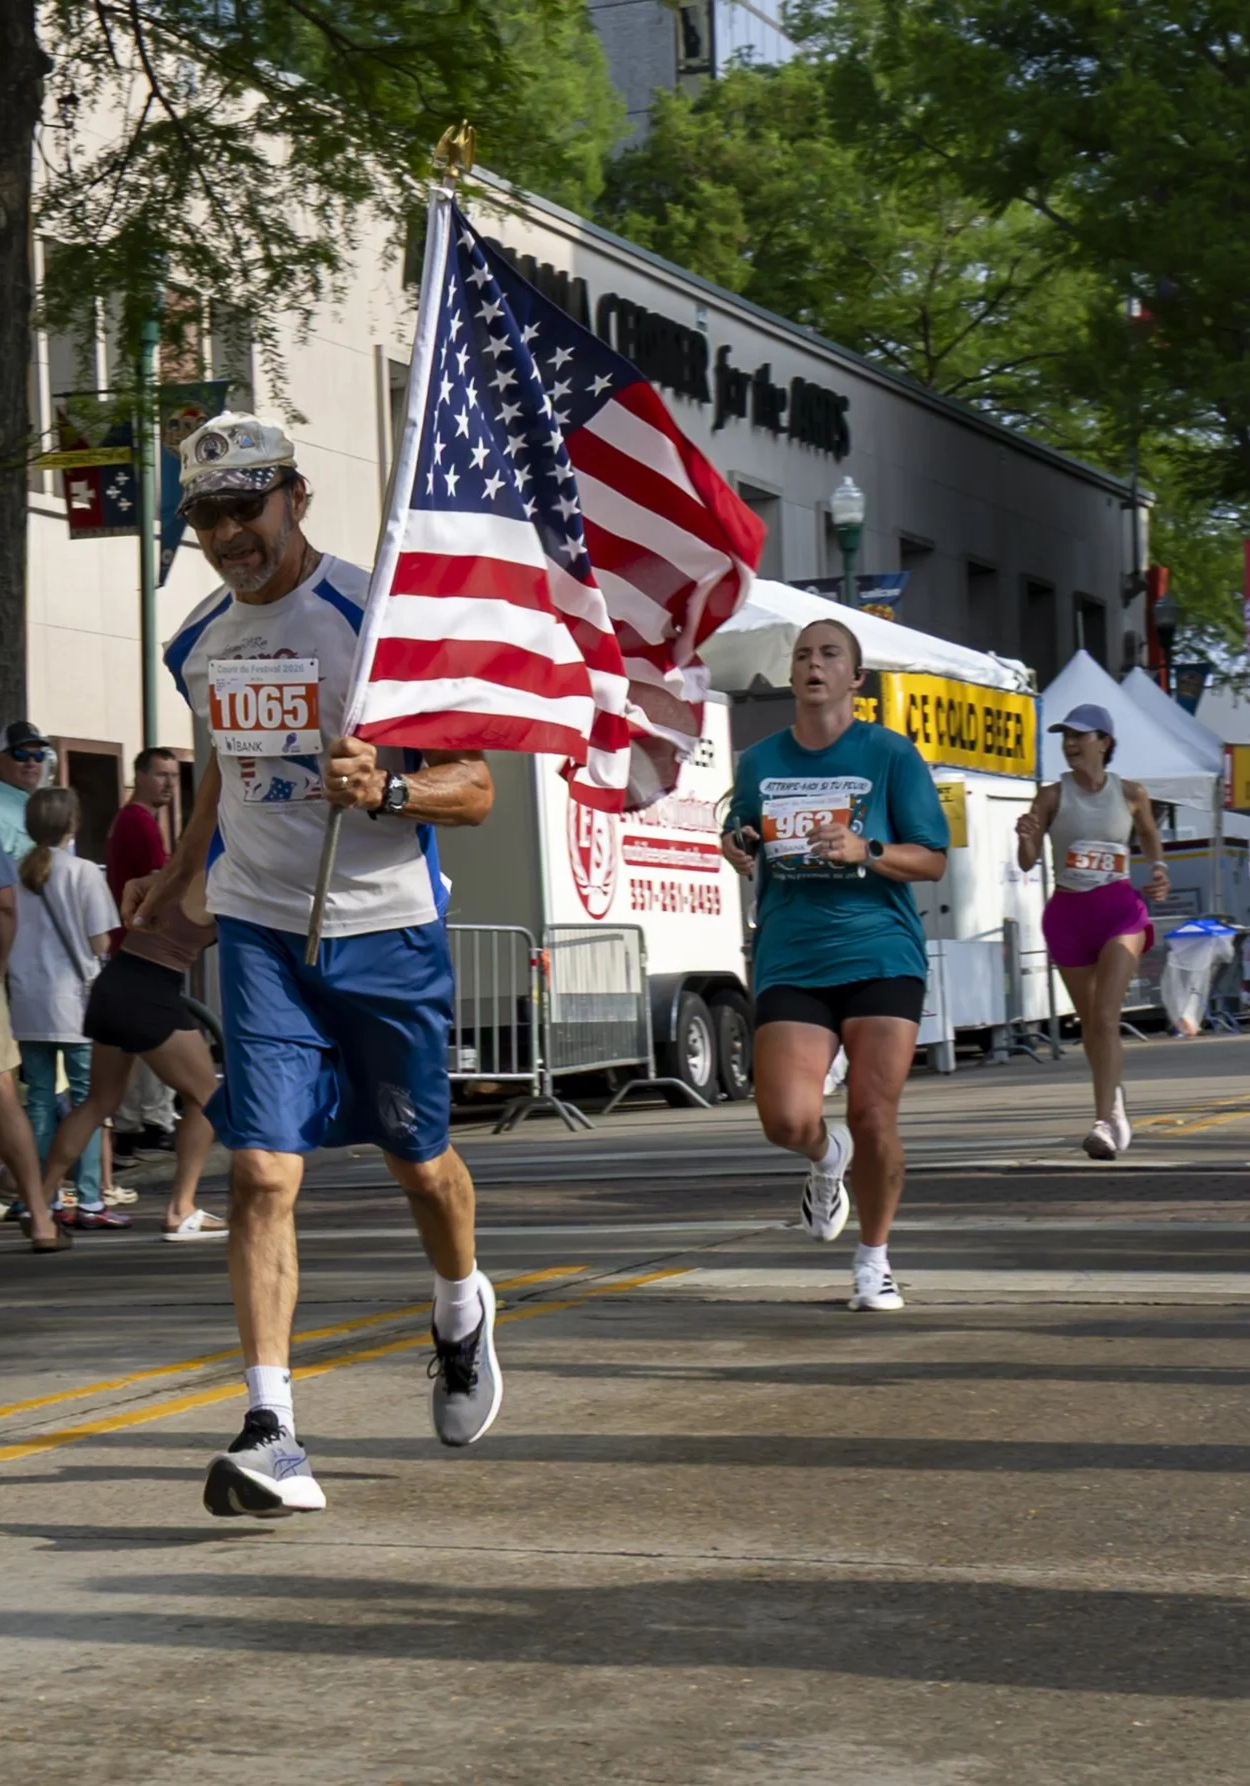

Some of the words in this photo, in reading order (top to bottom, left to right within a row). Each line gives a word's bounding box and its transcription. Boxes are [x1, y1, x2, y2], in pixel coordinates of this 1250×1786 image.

[216, 685, 309, 729] 1065
[935, 695, 978, 752] COLD
[983, 706, 1026, 759] BEER
[1074, 852, 1116, 872] 578
